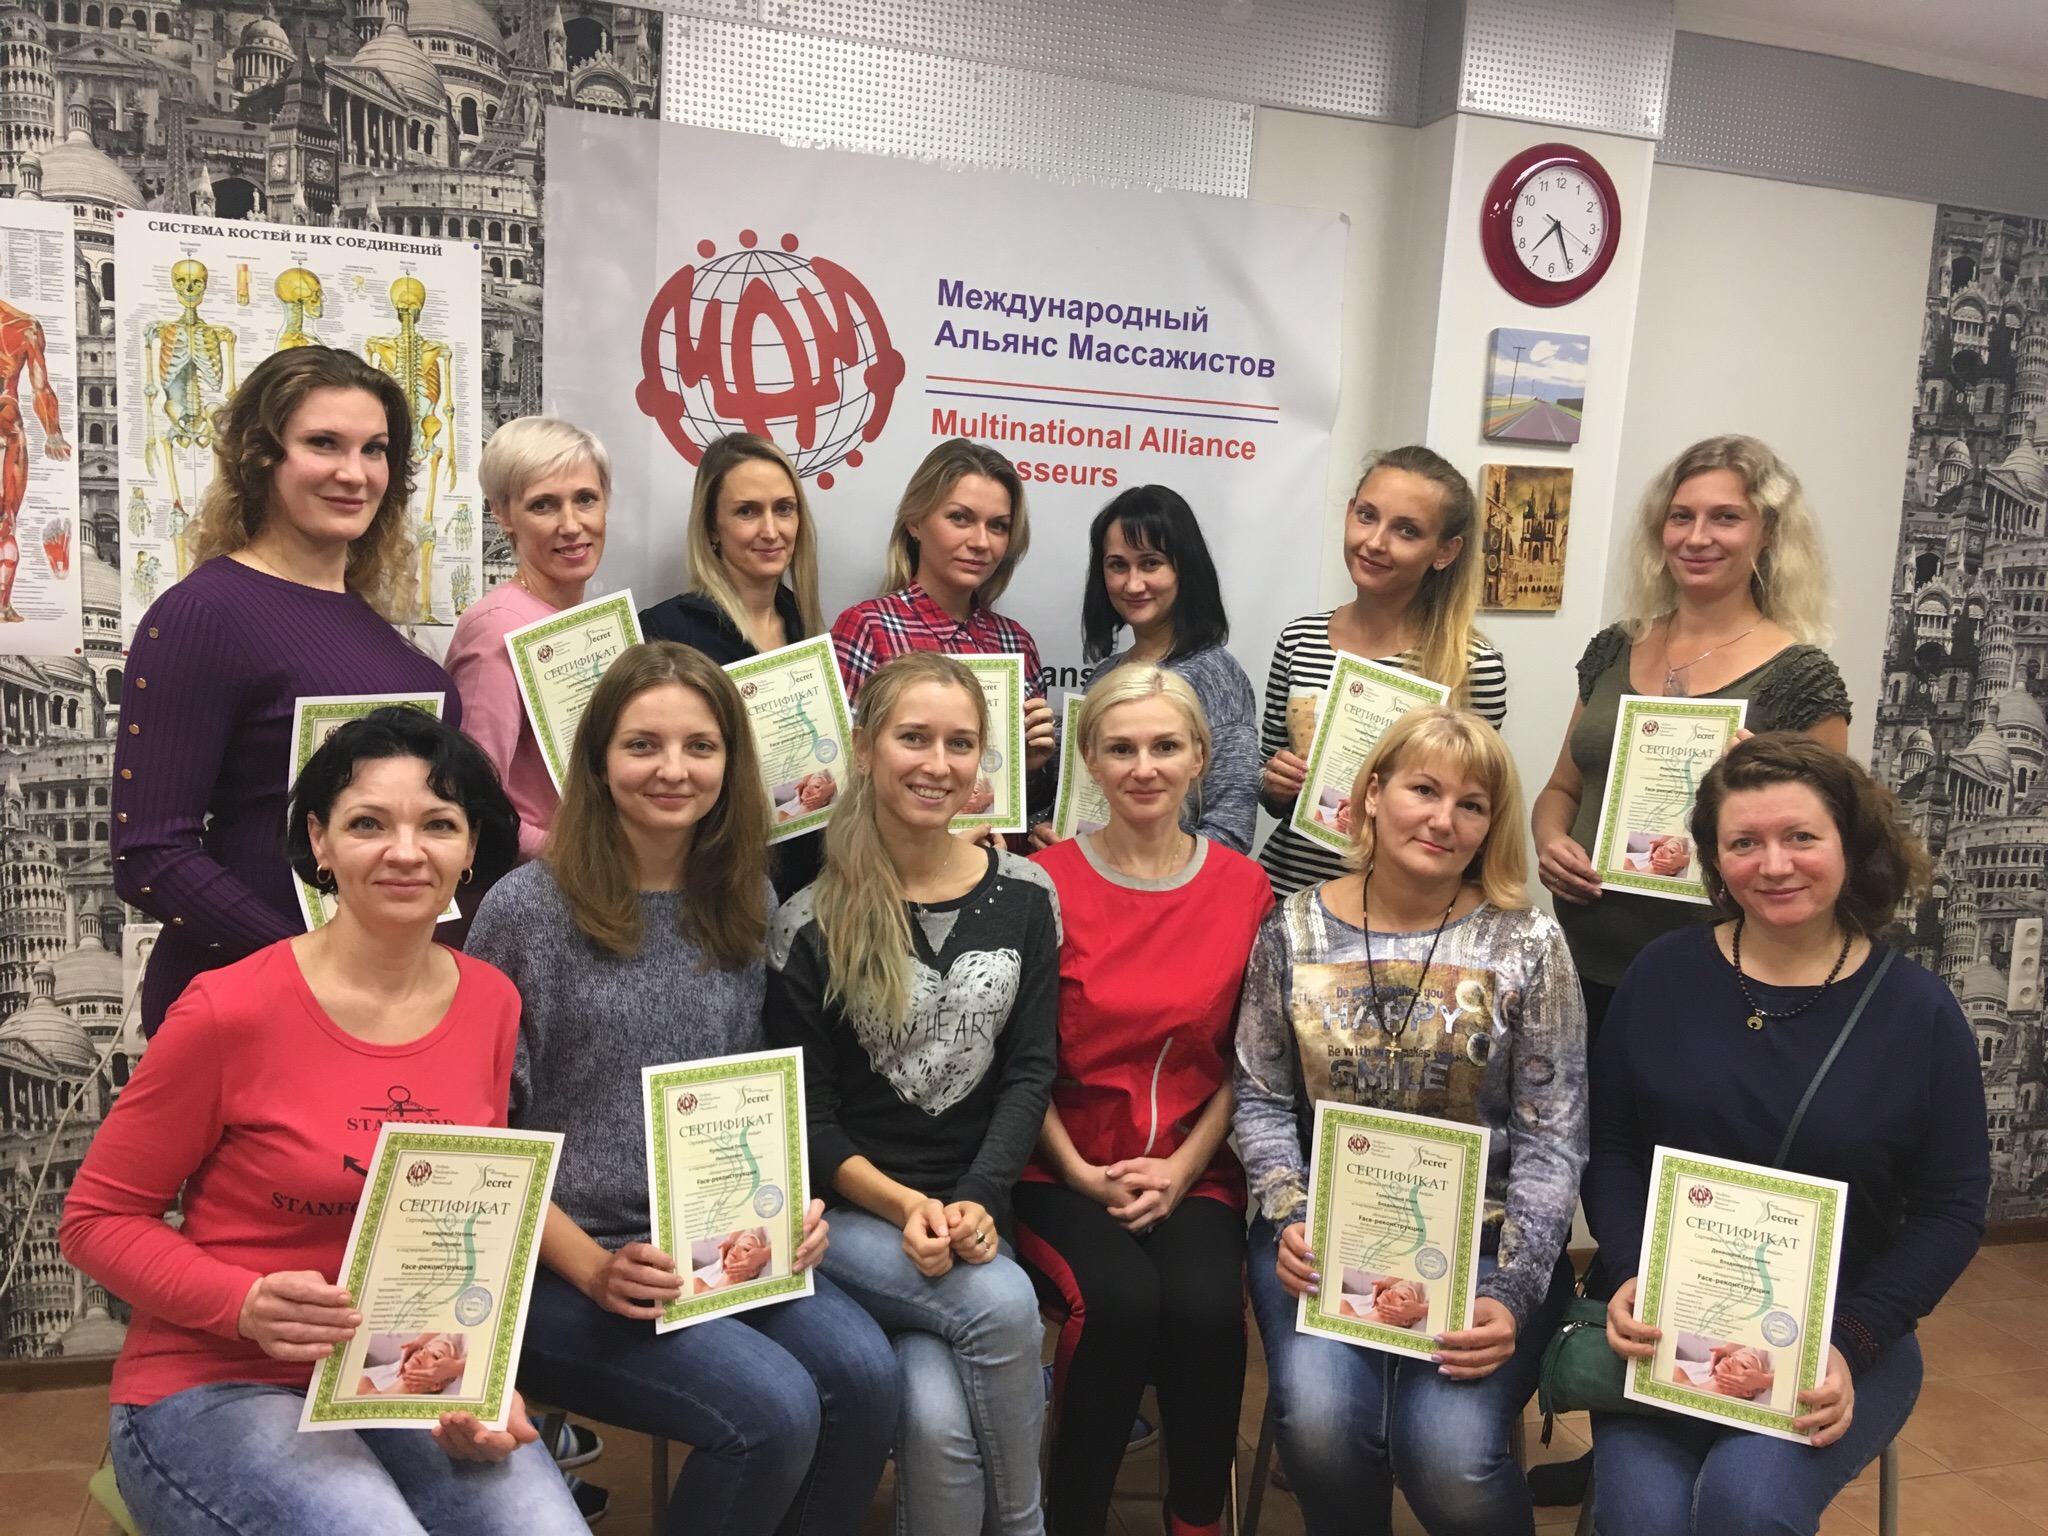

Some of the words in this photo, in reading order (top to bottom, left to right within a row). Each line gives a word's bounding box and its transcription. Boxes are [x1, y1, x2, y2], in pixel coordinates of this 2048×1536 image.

[1539, 181, 1549, 192] 11
[1555, 178, 1567, 189] 12
[1576, 184, 1581, 195] 1
[1524, 195, 1536, 206] 10
[1586, 201, 1594, 213] 2
[1516, 216, 1524, 227] 9
[1589, 223, 1596, 235] 3
[148, 220, 224, 237] СИСТЕМА
[228, 228, 291, 242] КОСТЕЙ
[295, 233, 307, 243] И
[310, 234, 332, 245] ИХ
[336, 236, 443, 257] СОЕДИНЕНИЙ
[1519, 237, 1526, 249] 8
[1581, 244, 1589, 255] 4
[1531, 255, 1539, 267] 7
[1548, 262, 1555, 274] 6
[1567, 258, 1574, 270] 5
[937, 278, 1209, 333] Международный
[935, 320, 1058, 358] Альянс
[1068, 335, 1276, 380] Массажистов
[931, 408, 1131, 451] Multinational
[1138, 425, 1257, 461] Alliance
[1009, 460, 1118, 488] sseurs
[587, 627, 612, 647] Secret
[543, 645, 618, 681] СЕРТИФИКАТ
[789, 668, 814, 688] Secret
[747, 685, 820, 717] СЕРТИФИКАТ
[1344, 703, 1394, 728] СЕРТИФИ
[1692, 723, 1715, 741] Secret
[1639, 744, 1716, 759] СЕРТИФИКАТ
[1424, 988, 1444, 1001] you
[1323, 1001, 1464, 1035] HAPPY
[886, 1021, 918, 1051] MY
[924, 1008, 1003, 1045] HEART
[1327, 1045, 1341, 1057] Be
[1343, 1045, 1371, 1058] with
[1329, 1059, 1449, 1092] SMILE
[740, 1084, 770, 1110] Secret
[679, 1112, 774, 1139] СЕРТИФИКАТ
[1413, 1145, 1448, 1170] Secret
[482, 1163, 513, 1189] Secret
[1346, 1163, 1450, 1191] СЕРТИФИКАТ
[399, 1198, 511, 1216] СЕРТИФИКАТ
[1762, 1200, 1799, 1226] Secret
[1358, 1215, 1424, 1233] Face-реконструкция
[1686, 1215, 1800, 1250] СЕРТИФИКАТ
[401, 1262, 474, 1271] Face-реконструкция
[1697, 1273, 1771, 1295] Face-реконструкция
